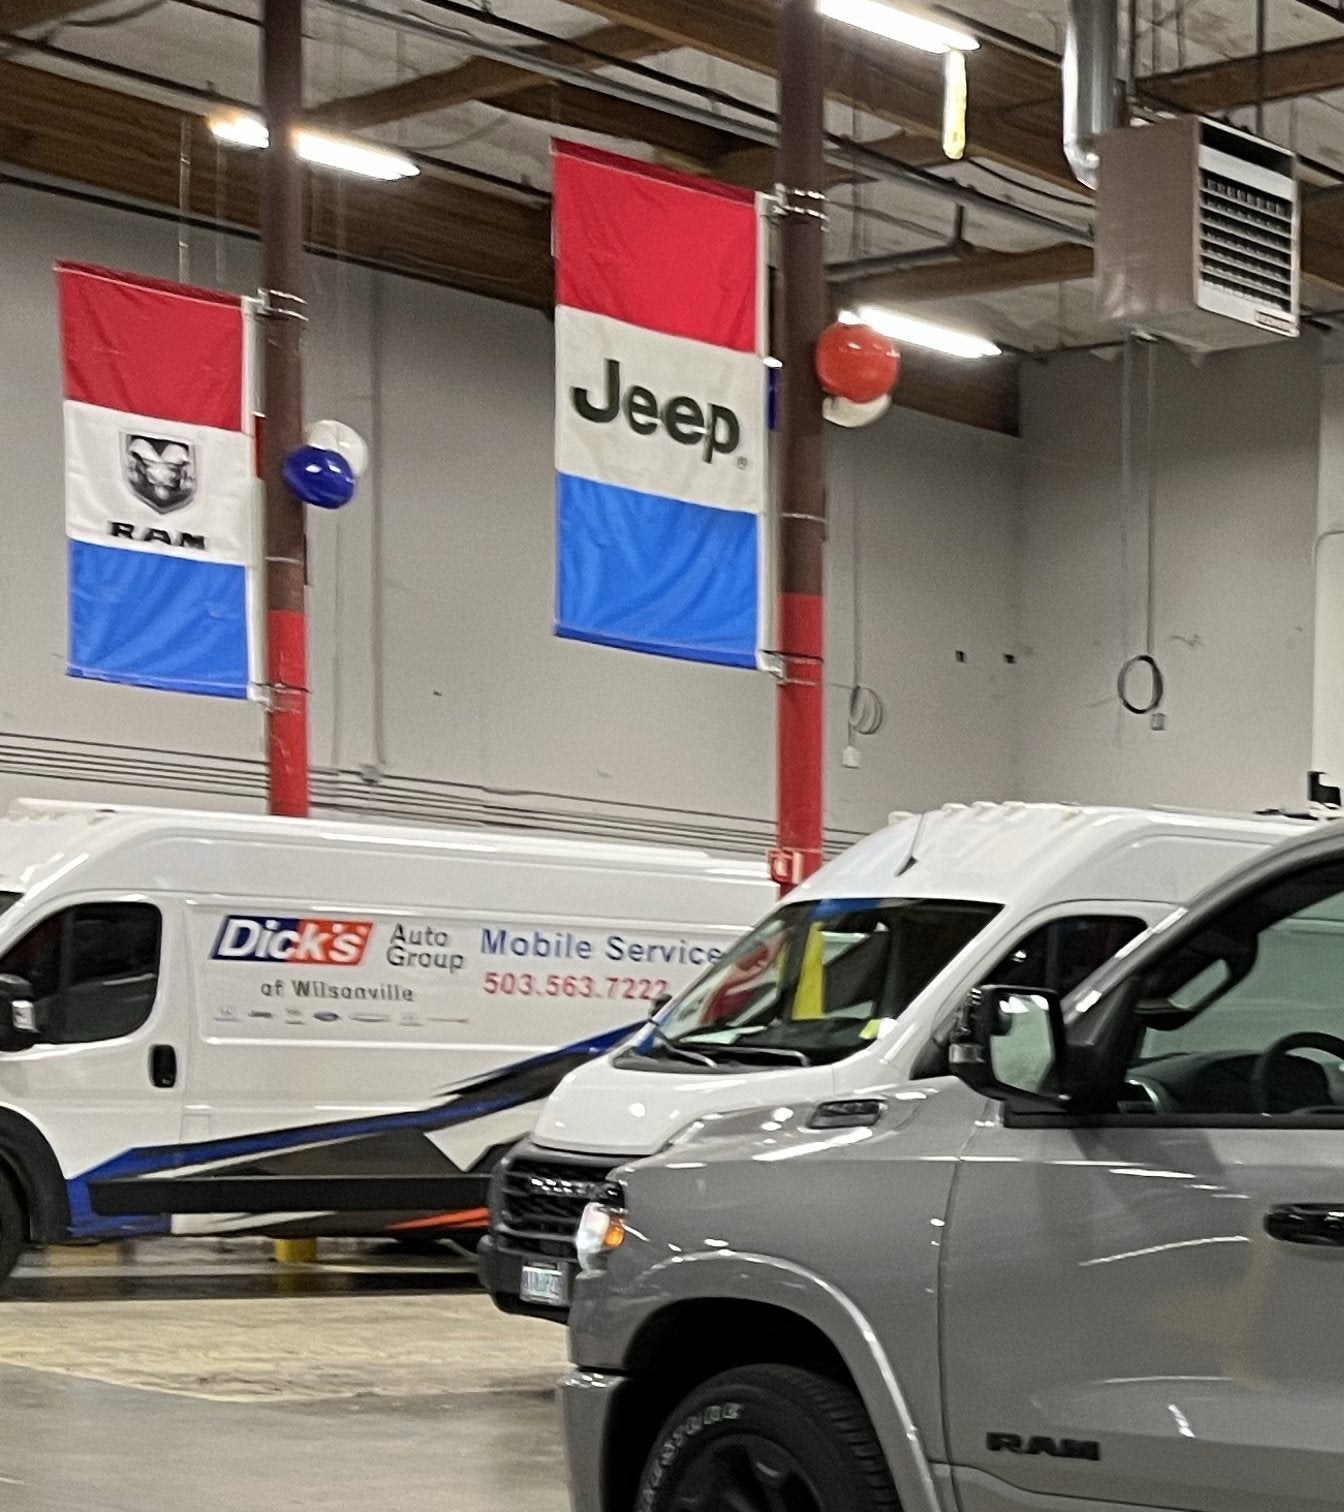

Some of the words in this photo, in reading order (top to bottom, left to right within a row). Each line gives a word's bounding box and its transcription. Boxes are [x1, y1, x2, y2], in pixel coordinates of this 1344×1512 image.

[570, 357, 741, 464] Jeep
[108, 521, 206, 550] RAM
[388, 923, 449, 947] Auto
[480, 928, 593, 959] Mobile
[386, 945, 465, 973] Group
[260, 979, 283, 997] of
[291, 979, 414, 1002] Wilsonville
[483, 972, 669, 1000] 503.563.7222
[986, 1432, 1100, 1461] RAM
